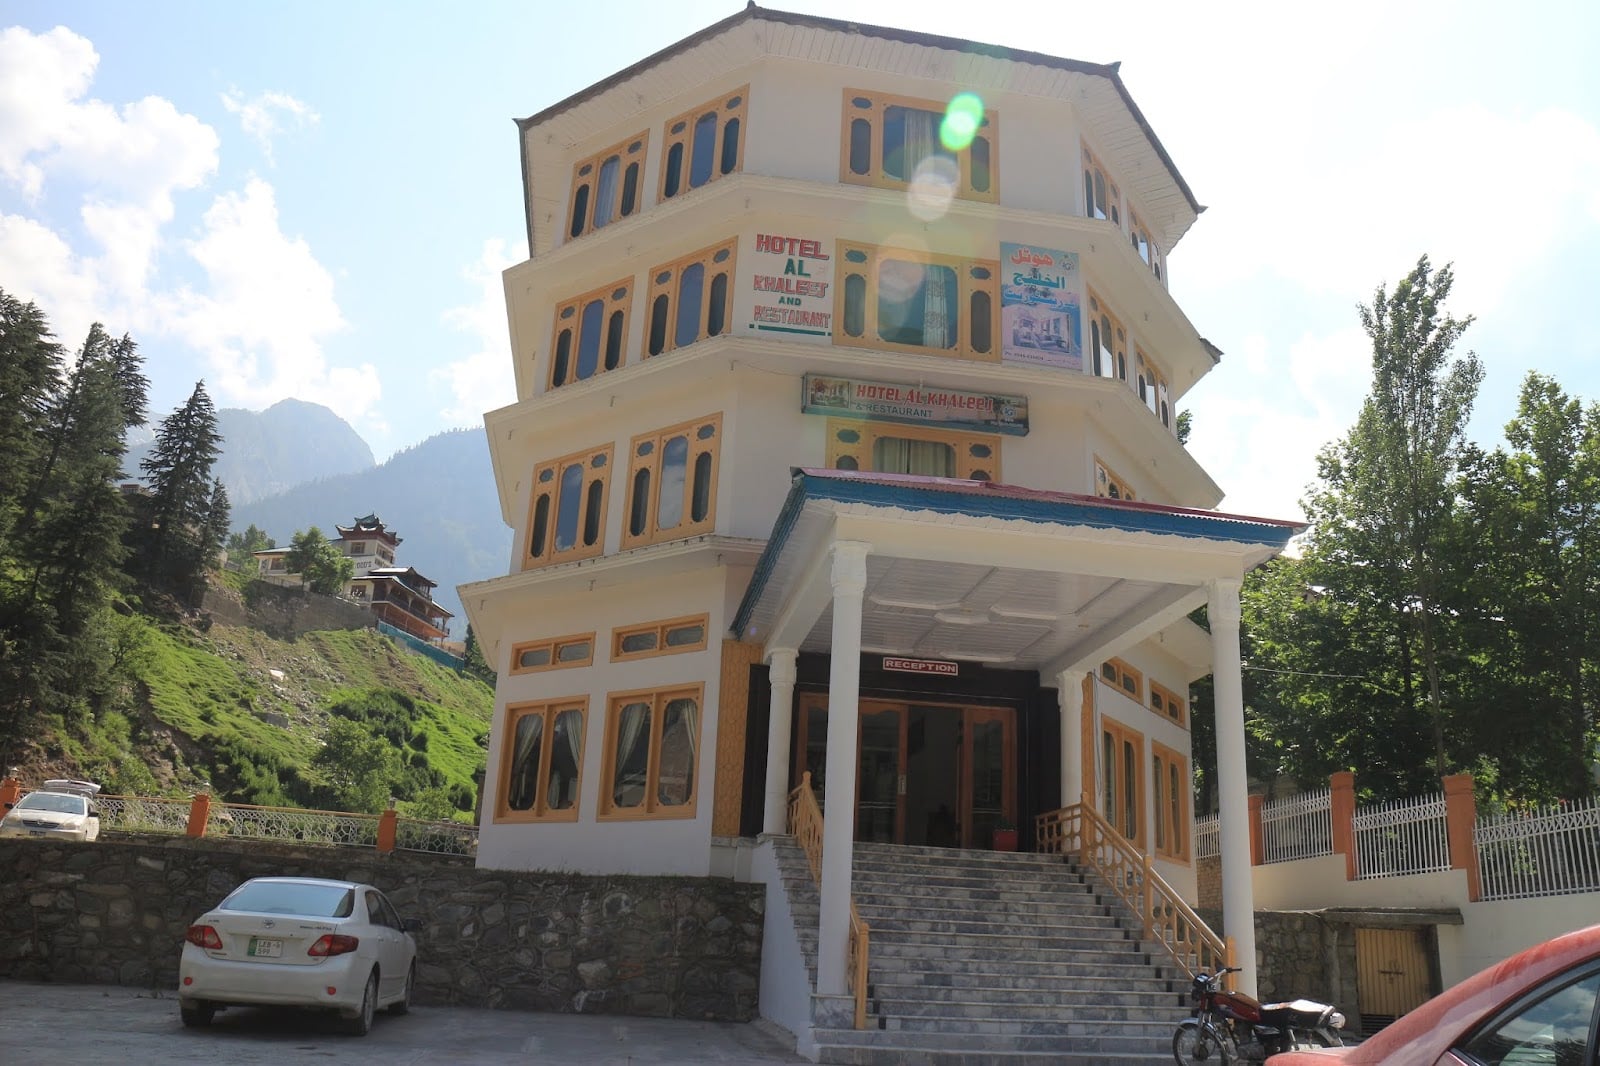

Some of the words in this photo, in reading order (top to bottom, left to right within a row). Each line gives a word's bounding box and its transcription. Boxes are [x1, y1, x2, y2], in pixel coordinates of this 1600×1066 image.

[756, 234, 829, 260] HOTEL
[784, 258, 811, 277] AL
[778, 296, 802, 306] AND
[754, 305, 831, 328] RESTAURANT
[906, 388, 922, 404] AL
[867, 403, 933, 418] RESTAURANT
[885, 660, 956, 673] RECEPTION
